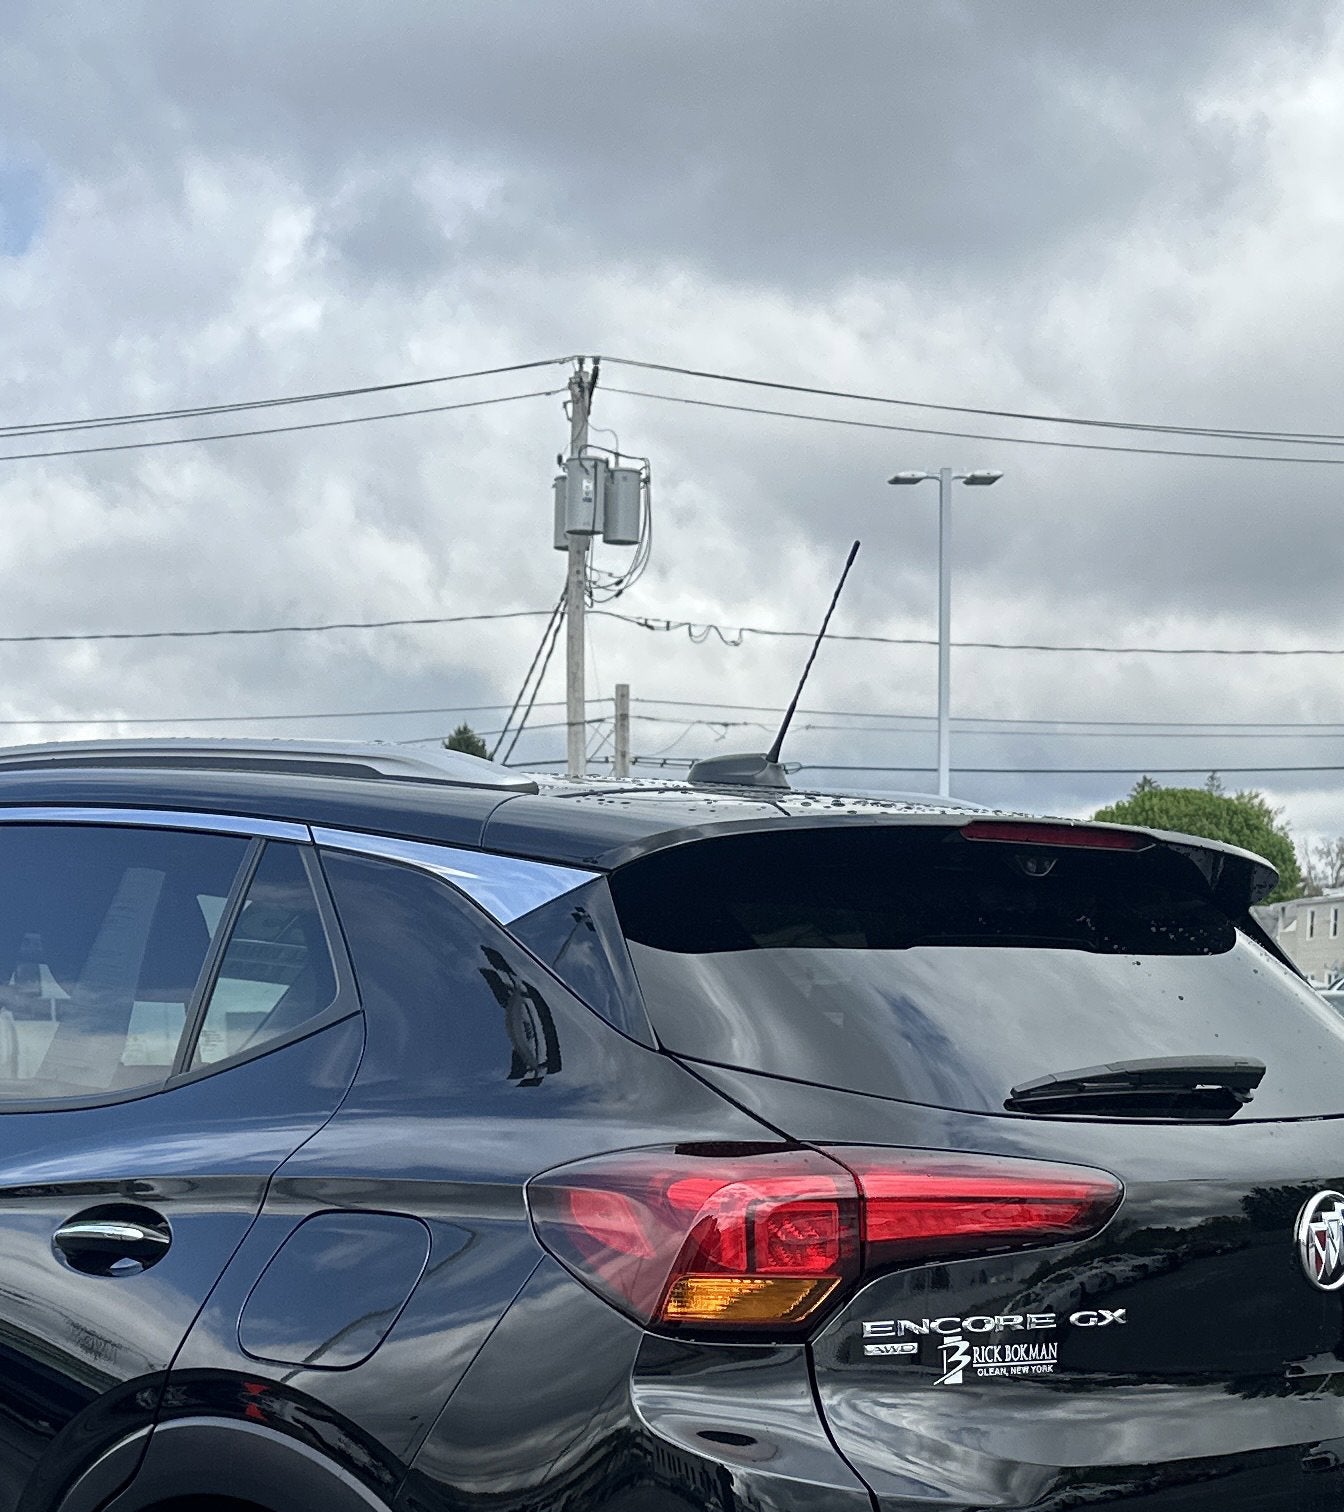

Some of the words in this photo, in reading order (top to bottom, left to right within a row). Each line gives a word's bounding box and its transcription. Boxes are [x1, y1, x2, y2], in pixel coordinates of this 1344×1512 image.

[862, 1313, 1057, 1337] ENCORE
[1069, 1308, 1127, 1328] GX
[873, 1344, 917, 1355] AWD
[972, 1345, 1002, 1364] RICK
[1005, 1342, 1058, 1362] BOKMAN
[977, 1367, 1009, 1377] OLEAN,
[1010, 1366, 1030, 1375] NEW
[1030, 1364, 1054, 1374] YORK
